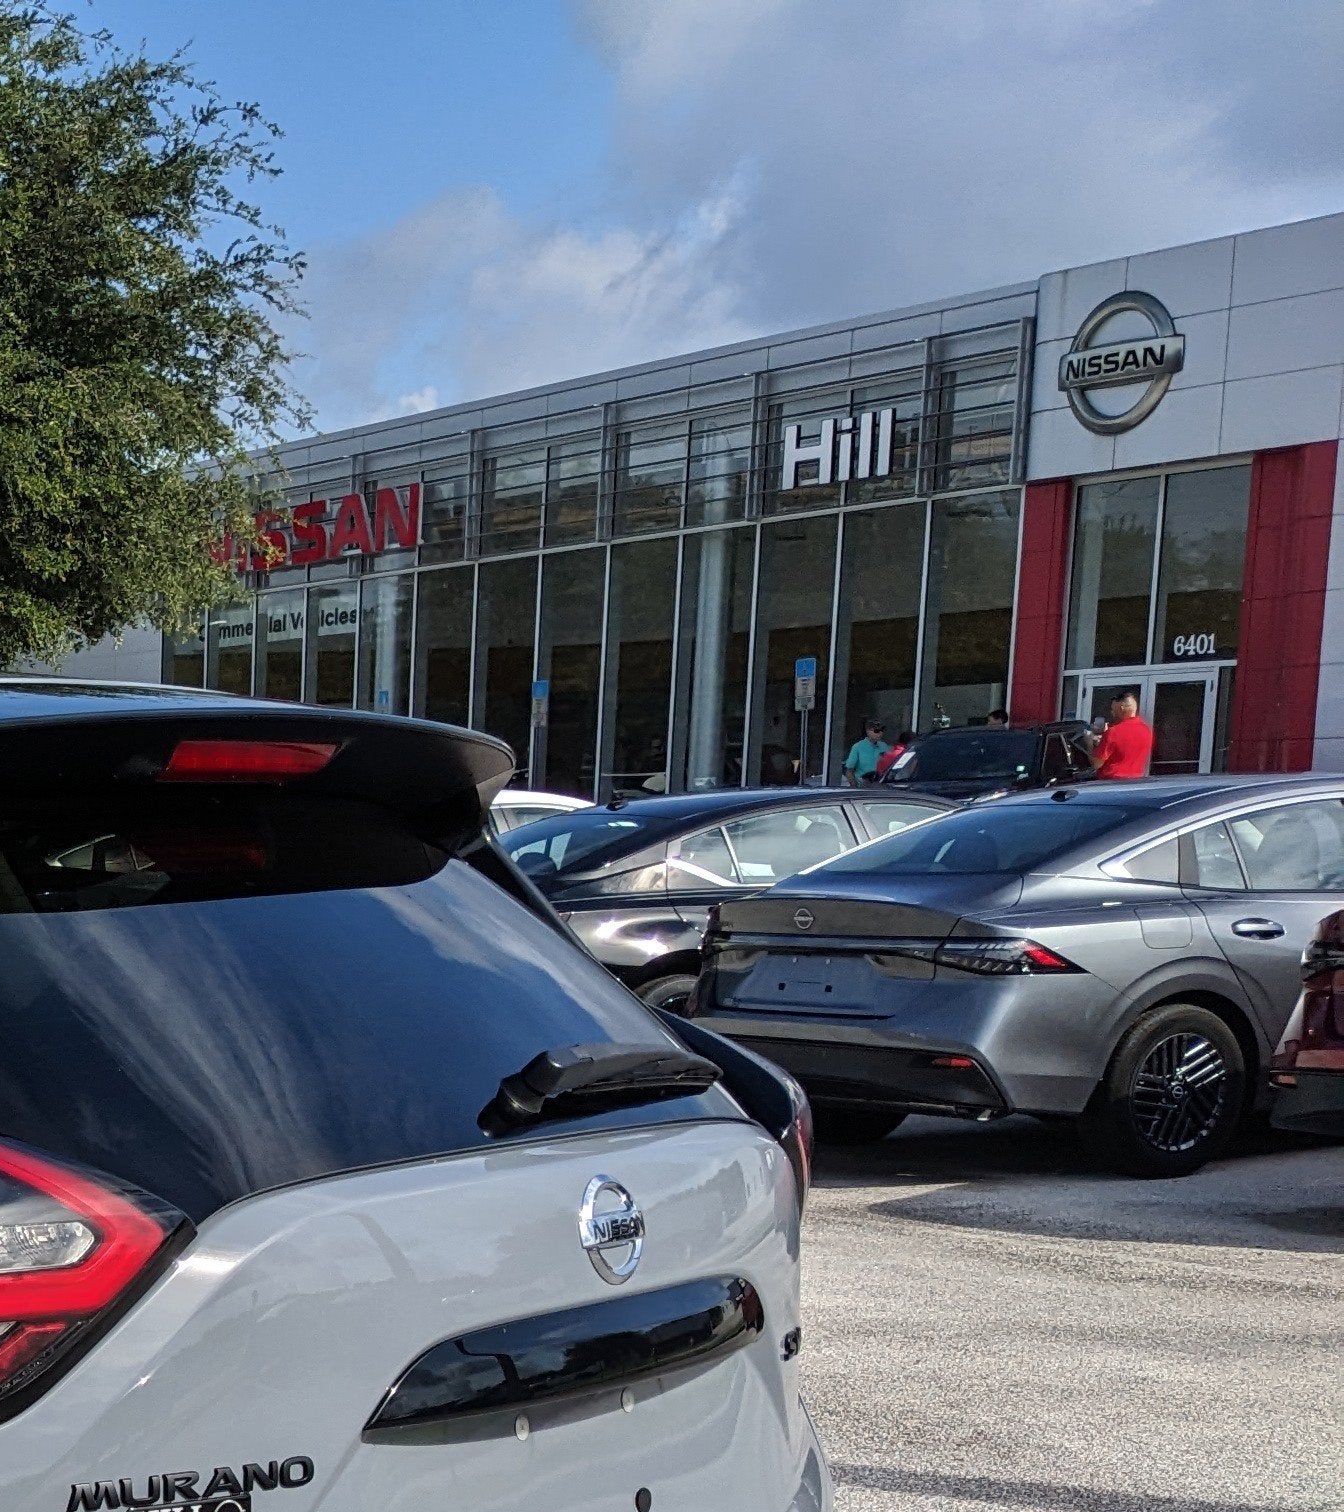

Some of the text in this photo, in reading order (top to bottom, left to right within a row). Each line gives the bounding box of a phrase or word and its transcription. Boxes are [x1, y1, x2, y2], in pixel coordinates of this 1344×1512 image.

[1065, 344, 1166, 381] NISSAN
[782, 408, 894, 490] Hill
[1173, 633, 1216, 656] 6401
[592, 1213, 646, 1241] NISSAN
